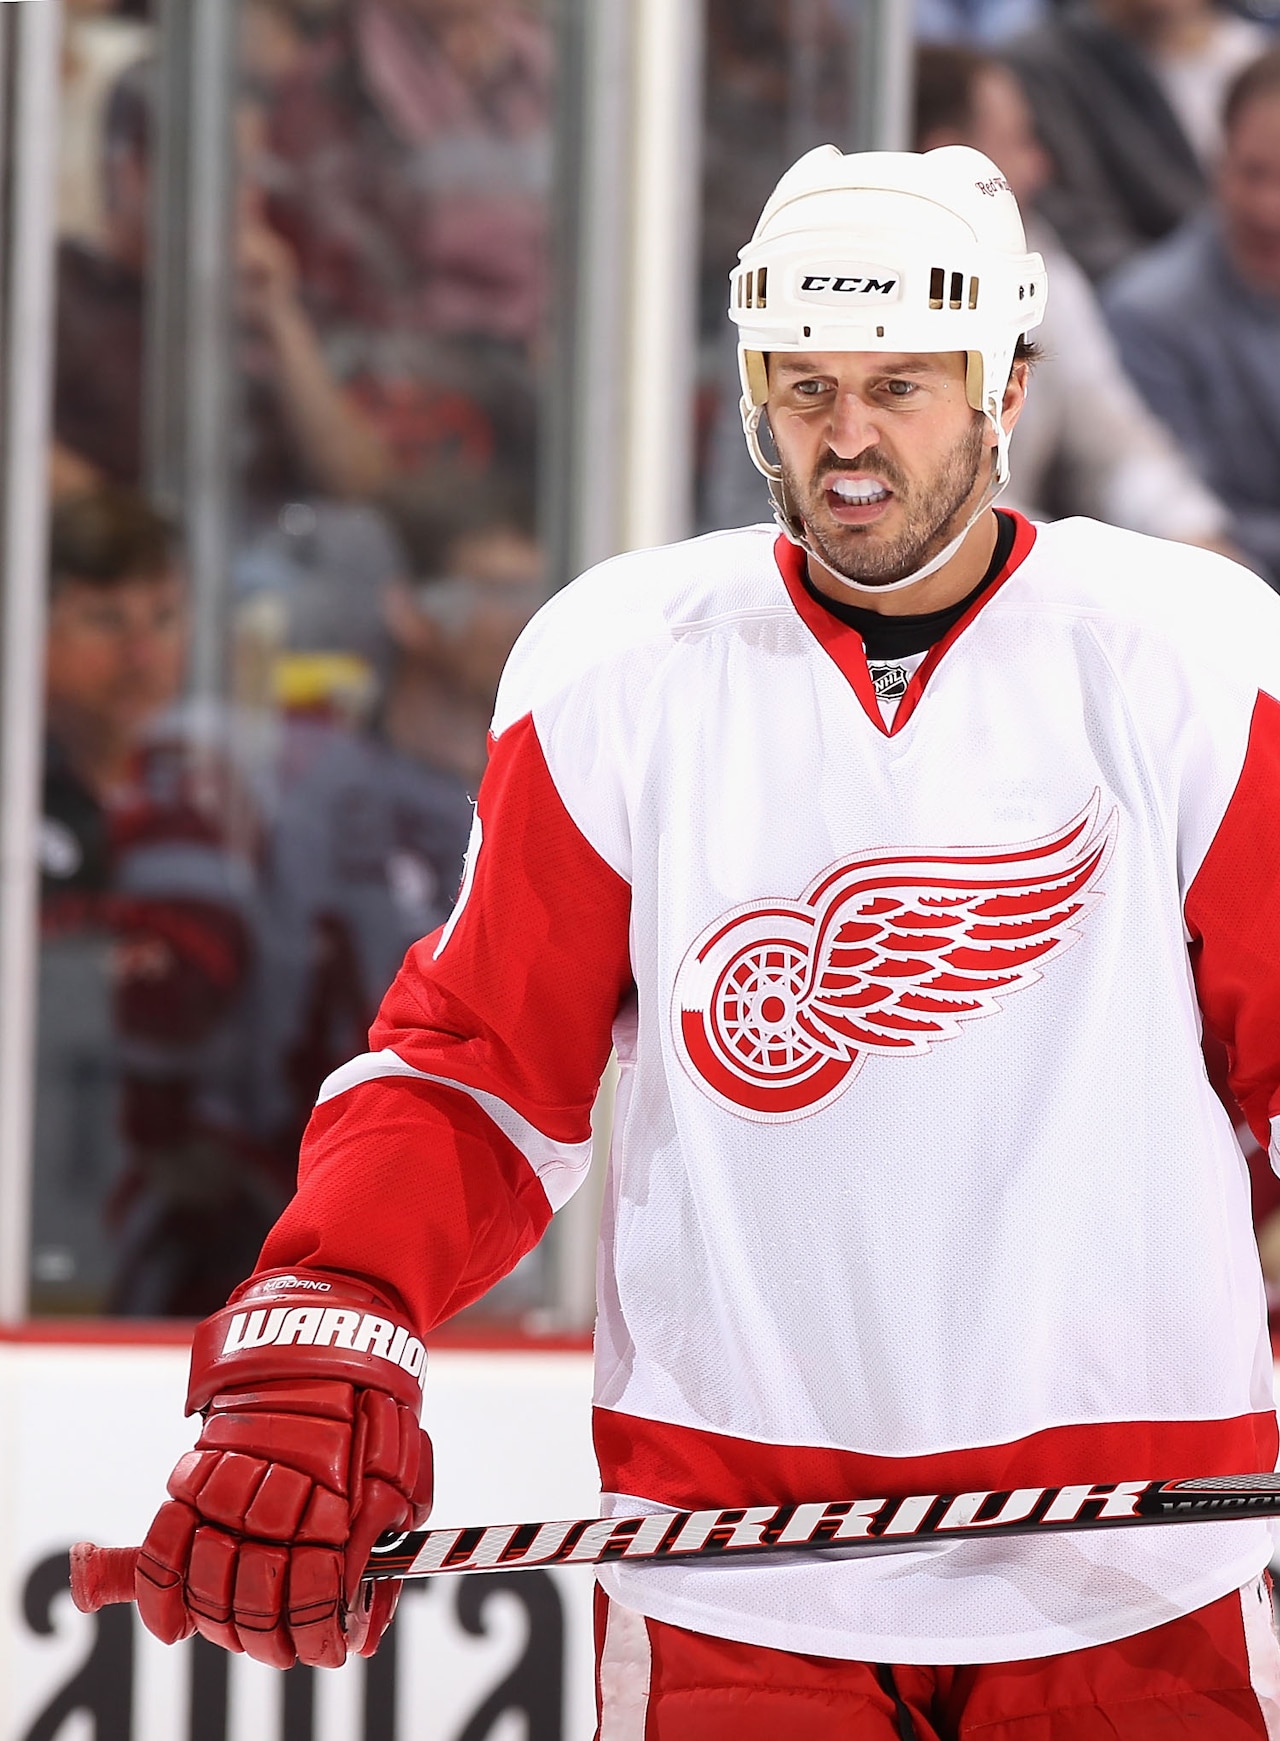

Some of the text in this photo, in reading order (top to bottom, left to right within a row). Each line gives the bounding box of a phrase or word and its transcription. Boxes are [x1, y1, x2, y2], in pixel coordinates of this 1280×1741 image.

[800, 276, 896, 294] CCM
[874, 671, 903, 693] NHL
[262, 1280, 332, 1292] MODANO
[221, 1306, 428, 1390] WARRIO
[407, 1480, 1153, 1574] WARRIOR
